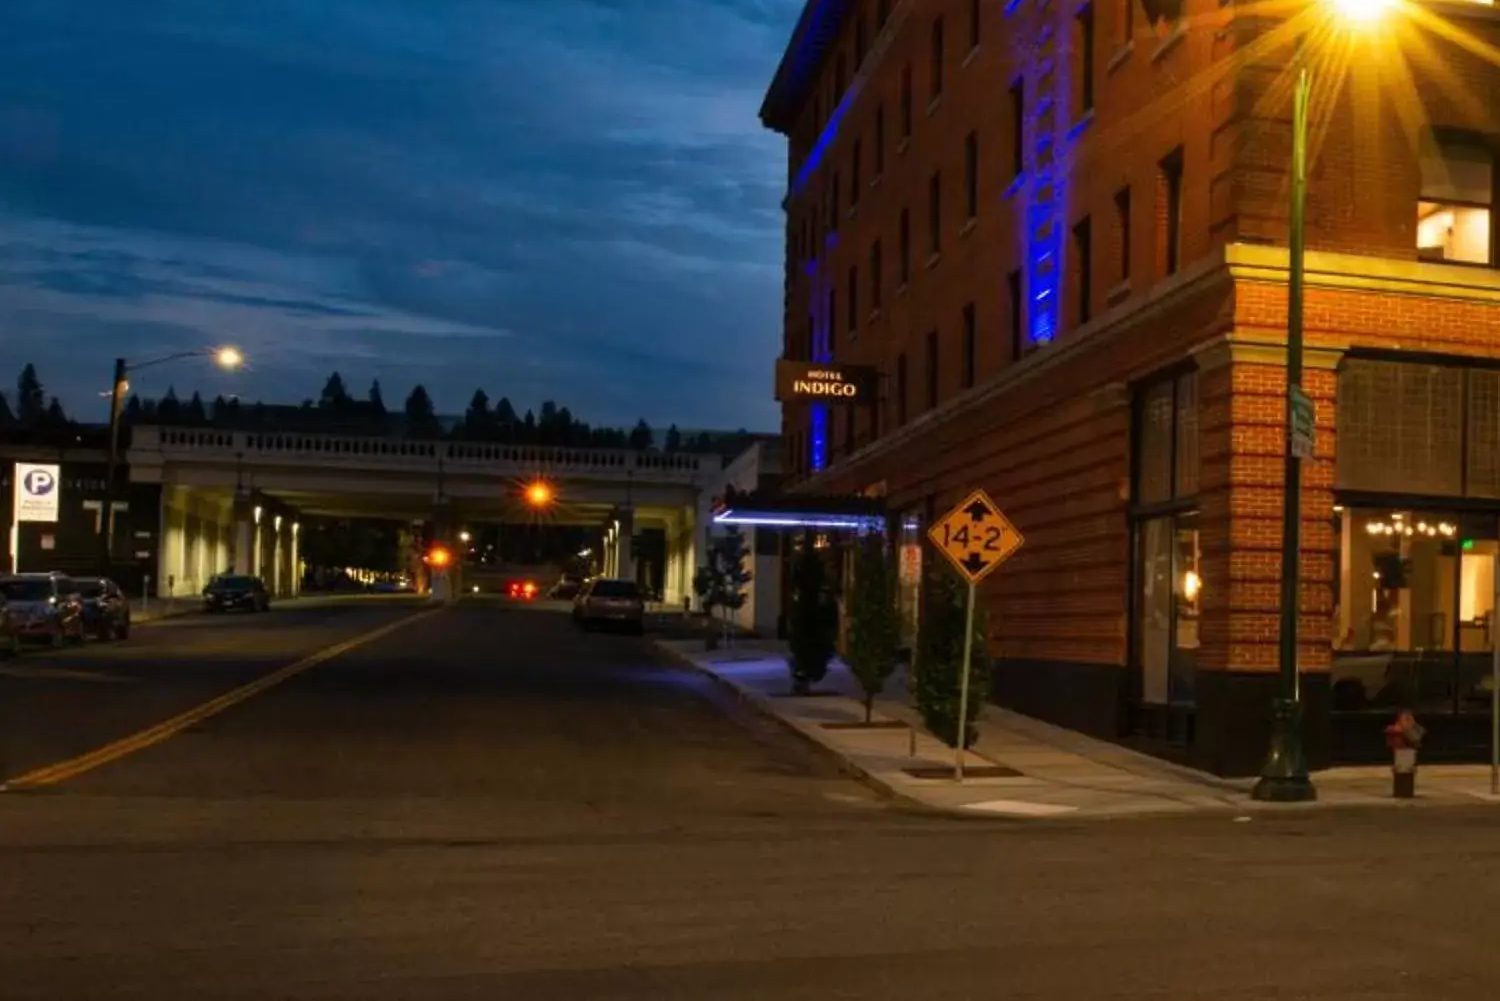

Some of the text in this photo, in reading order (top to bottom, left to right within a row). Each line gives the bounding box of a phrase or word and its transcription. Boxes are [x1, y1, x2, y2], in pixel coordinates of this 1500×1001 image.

[808, 370, 842, 380] HOTEL
[794, 380, 856, 397] INDIGO
[31, 472, 51, 494] P
